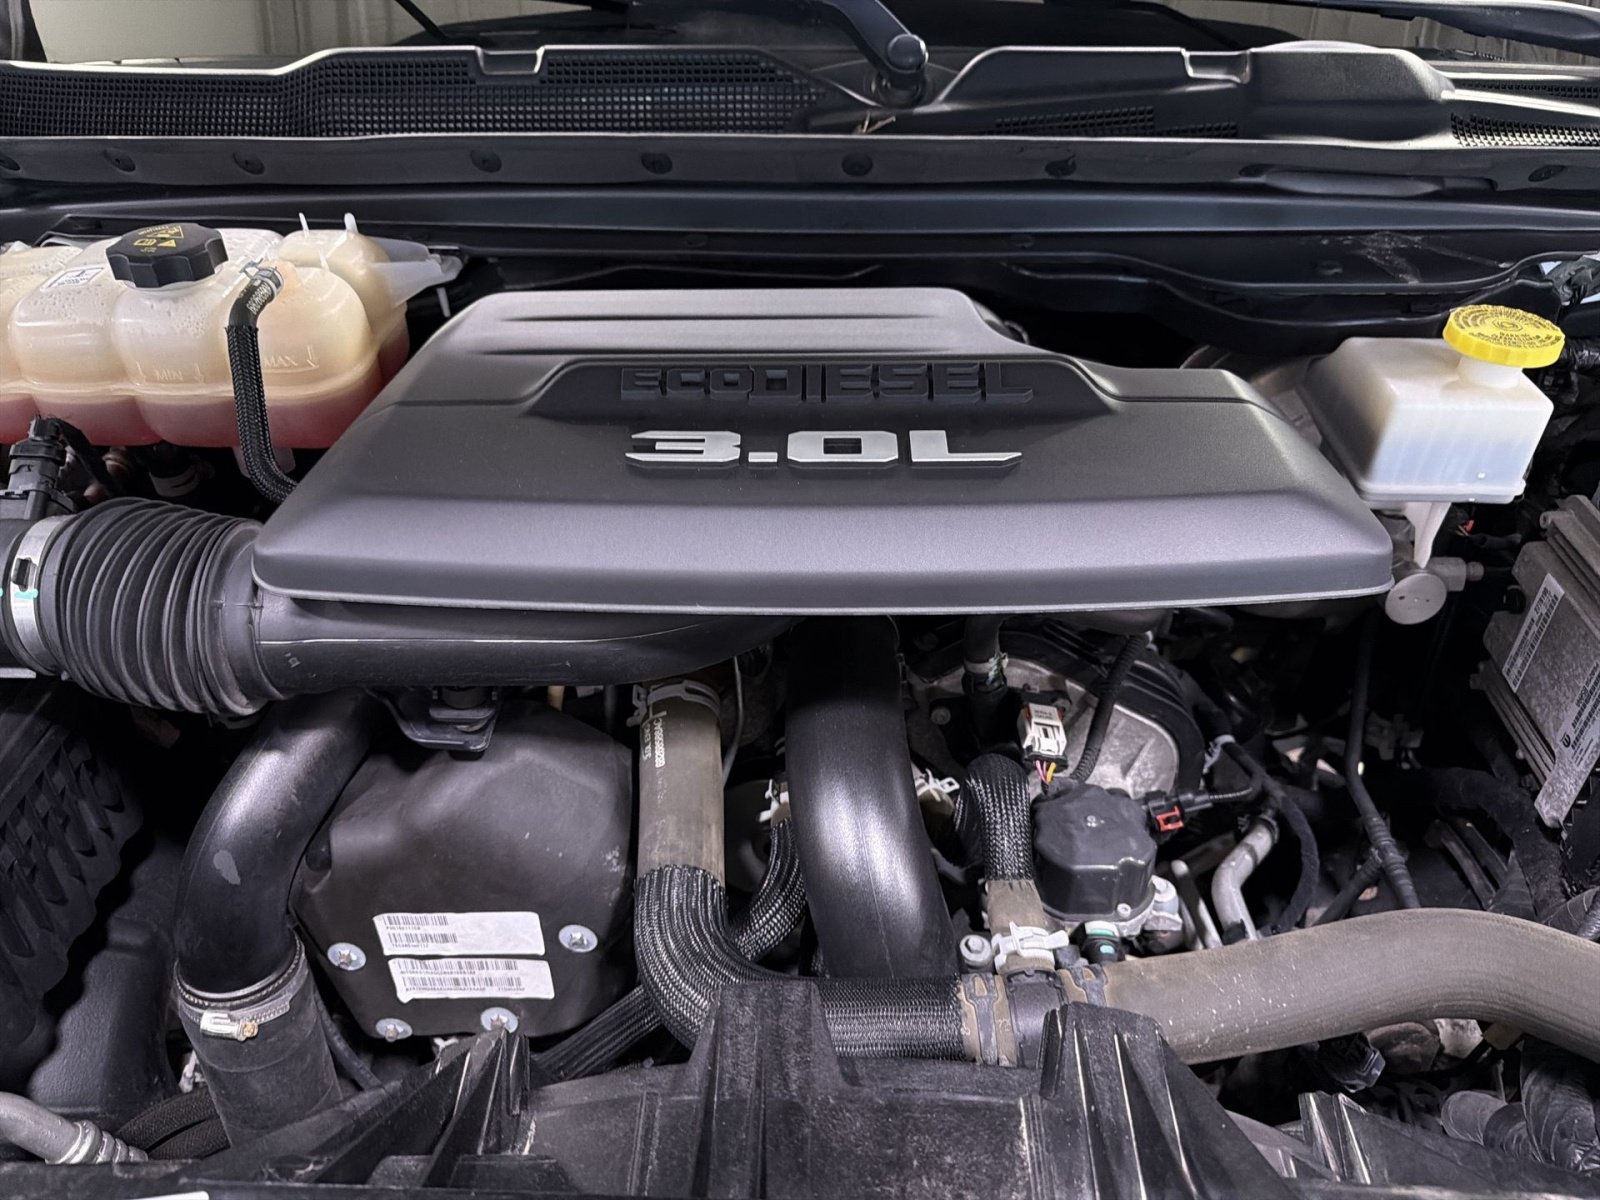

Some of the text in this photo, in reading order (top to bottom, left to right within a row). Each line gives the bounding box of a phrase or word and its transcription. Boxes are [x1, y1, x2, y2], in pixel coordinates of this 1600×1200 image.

[264, 355, 298, 368] MAX
[155, 368, 183, 381] MIN
[620, 364, 1033, 402] ECODIESEL
[625, 429, 1023, 466] 3.0L
